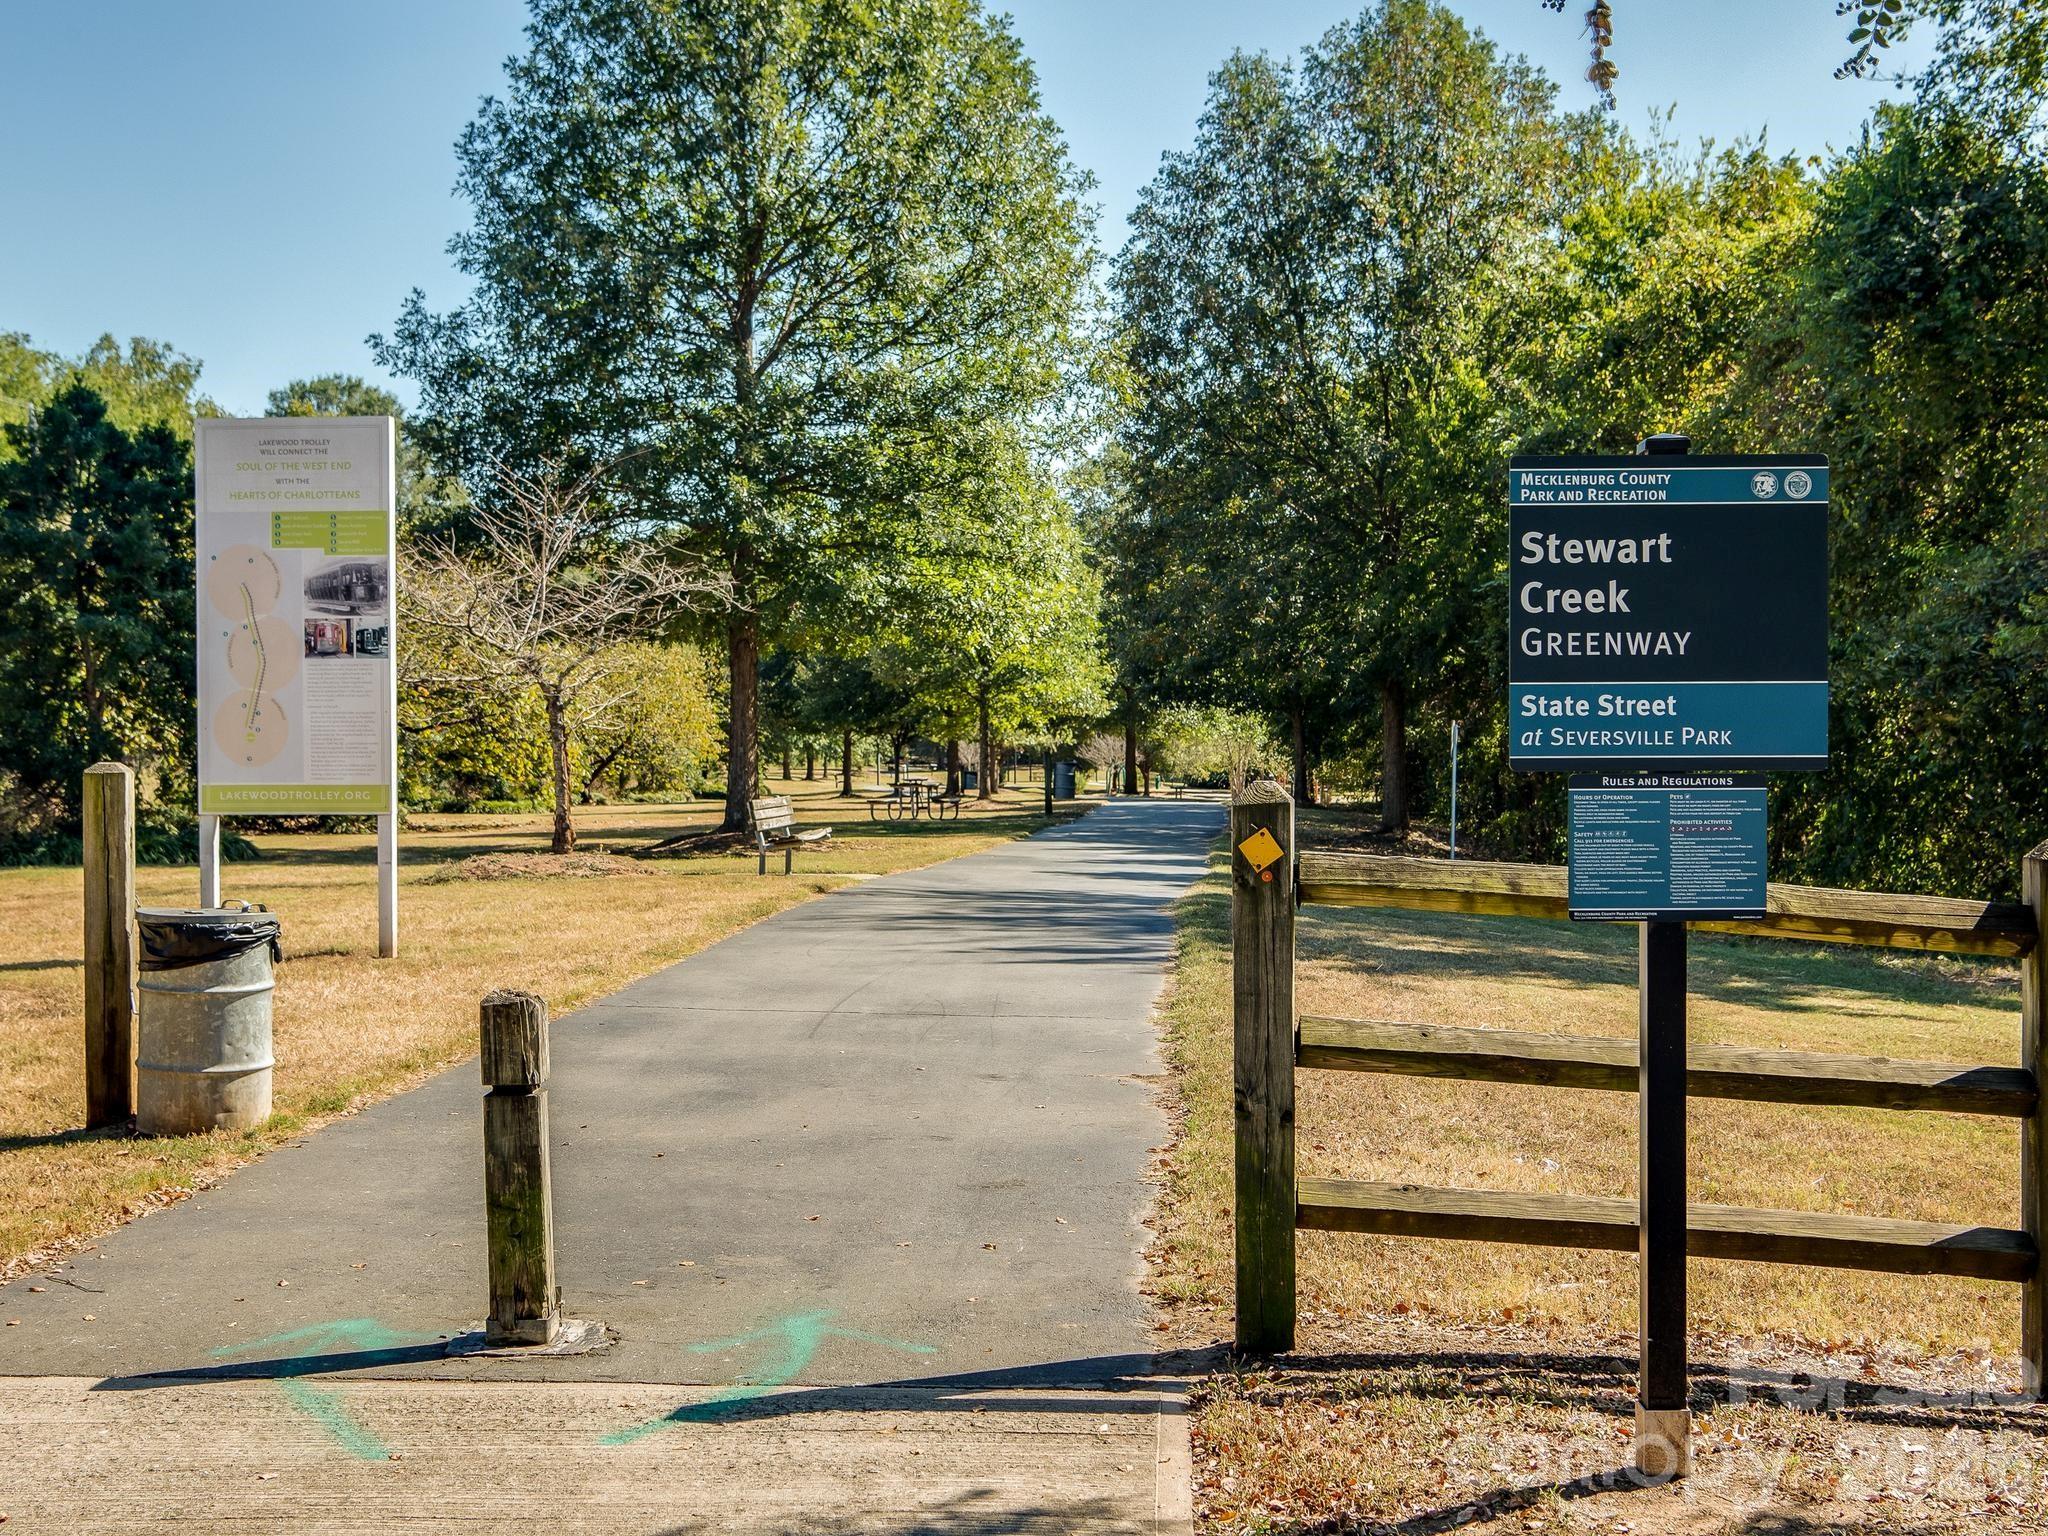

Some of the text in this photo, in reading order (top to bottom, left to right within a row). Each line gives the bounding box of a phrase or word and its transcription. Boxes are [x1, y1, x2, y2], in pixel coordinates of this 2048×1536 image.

[258, 439, 299, 447] LAKEWOOD
[278, 448, 313, 456] CONNECT
[236, 461, 352, 471] SOUL OF THE WEST END
[1520, 471, 1671, 486] MECKLENBURG COUNTY
[230, 490, 360, 500] HEARTS OF CHARLOTTEANS
[1520, 488, 1667, 502] PARK AND RECREATION
[1520, 531, 1673, 564] Stewart
[1520, 579, 1631, 613] Creek
[1520, 627, 1691, 657] GREENWAY
[1520, 693, 1677, 717] State Street
[1521, 726, 1732, 746] at SEVERSVILLE PARK
[1602, 776, 1733, 787] RULES AND REGULATIONS
[219, 791, 371, 801] LAKEWOODTROLLEY.ORG
